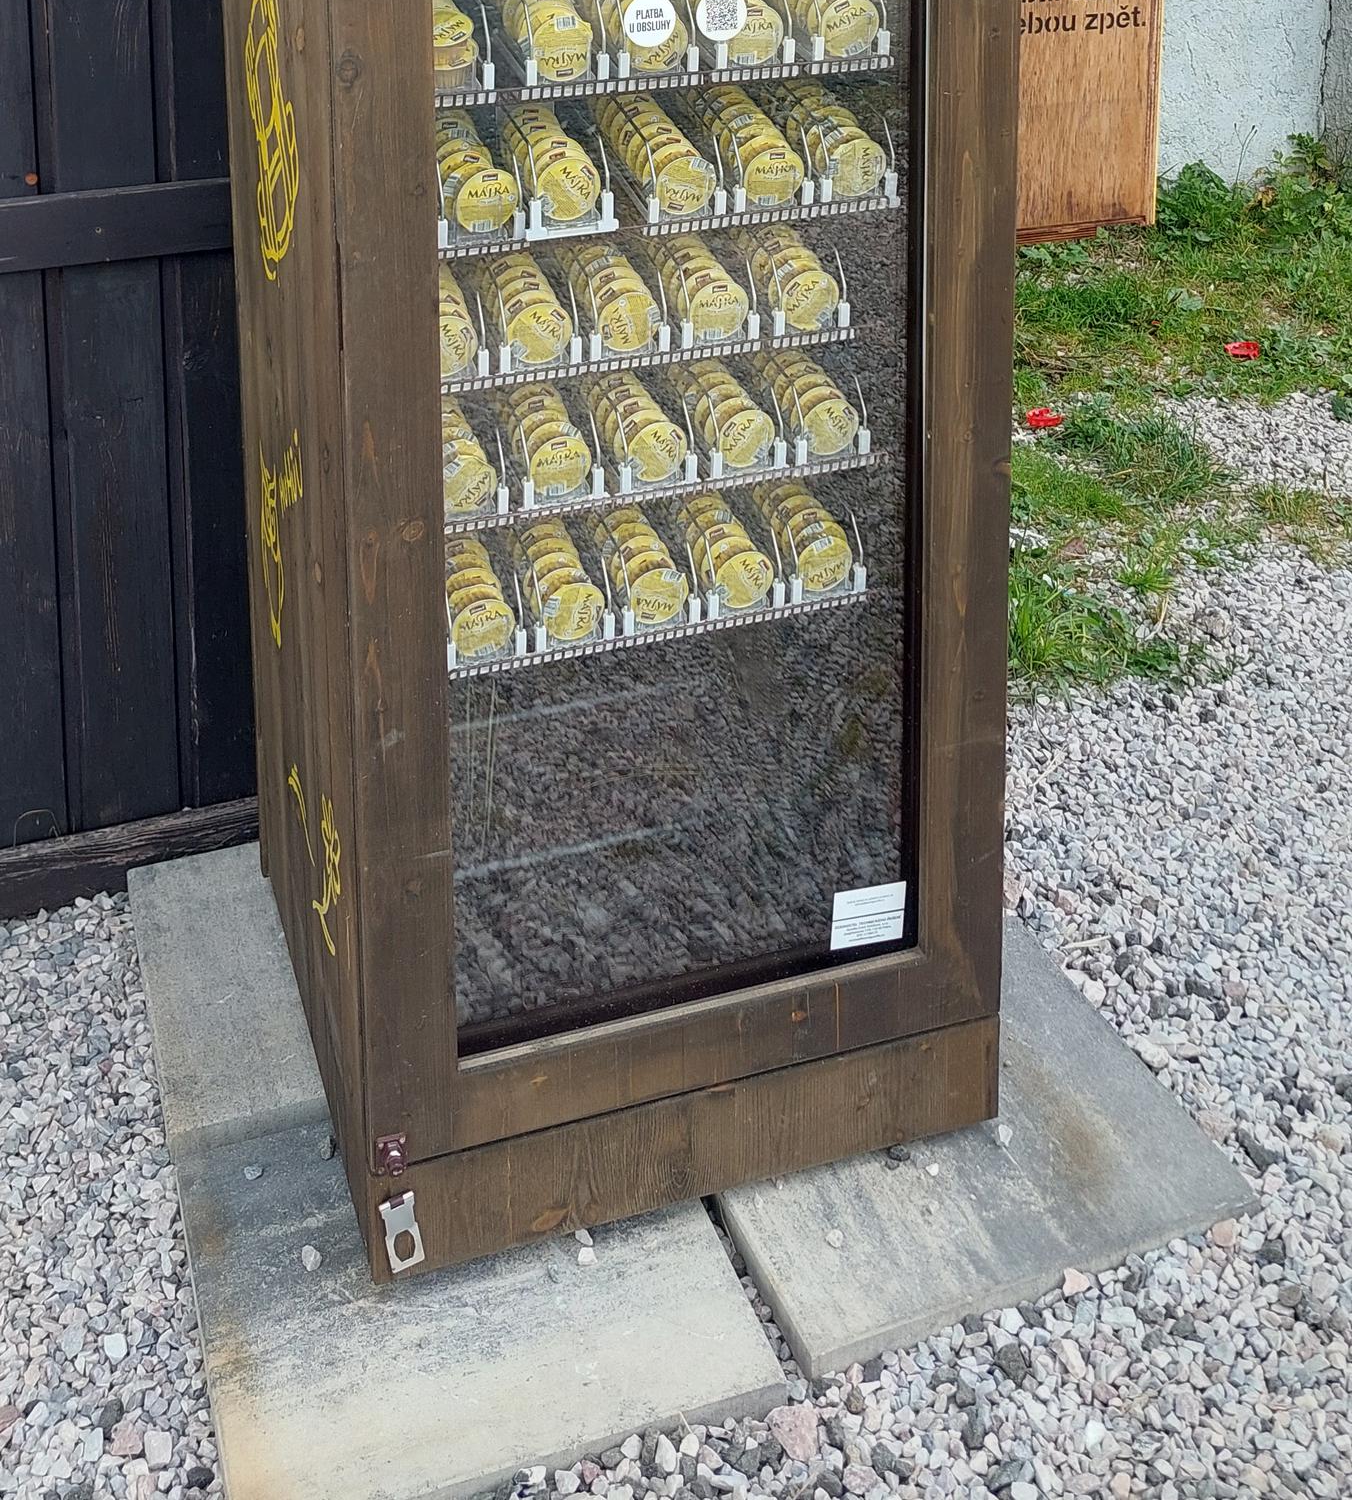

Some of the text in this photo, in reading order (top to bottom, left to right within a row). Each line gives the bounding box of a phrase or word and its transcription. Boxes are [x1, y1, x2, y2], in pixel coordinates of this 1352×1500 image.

[635, 8, 664, 20] PLATBA
[826, 7, 866, 32] MÁJKA
[1085, 5, 1146, 34] zpět.
[629, 20, 671, 33] U OBSLUHY
[541, 50, 587, 67] MÁJKA
[559, 167, 591, 199] MÁJKA
[468, 186, 510, 199] MÁJKA
